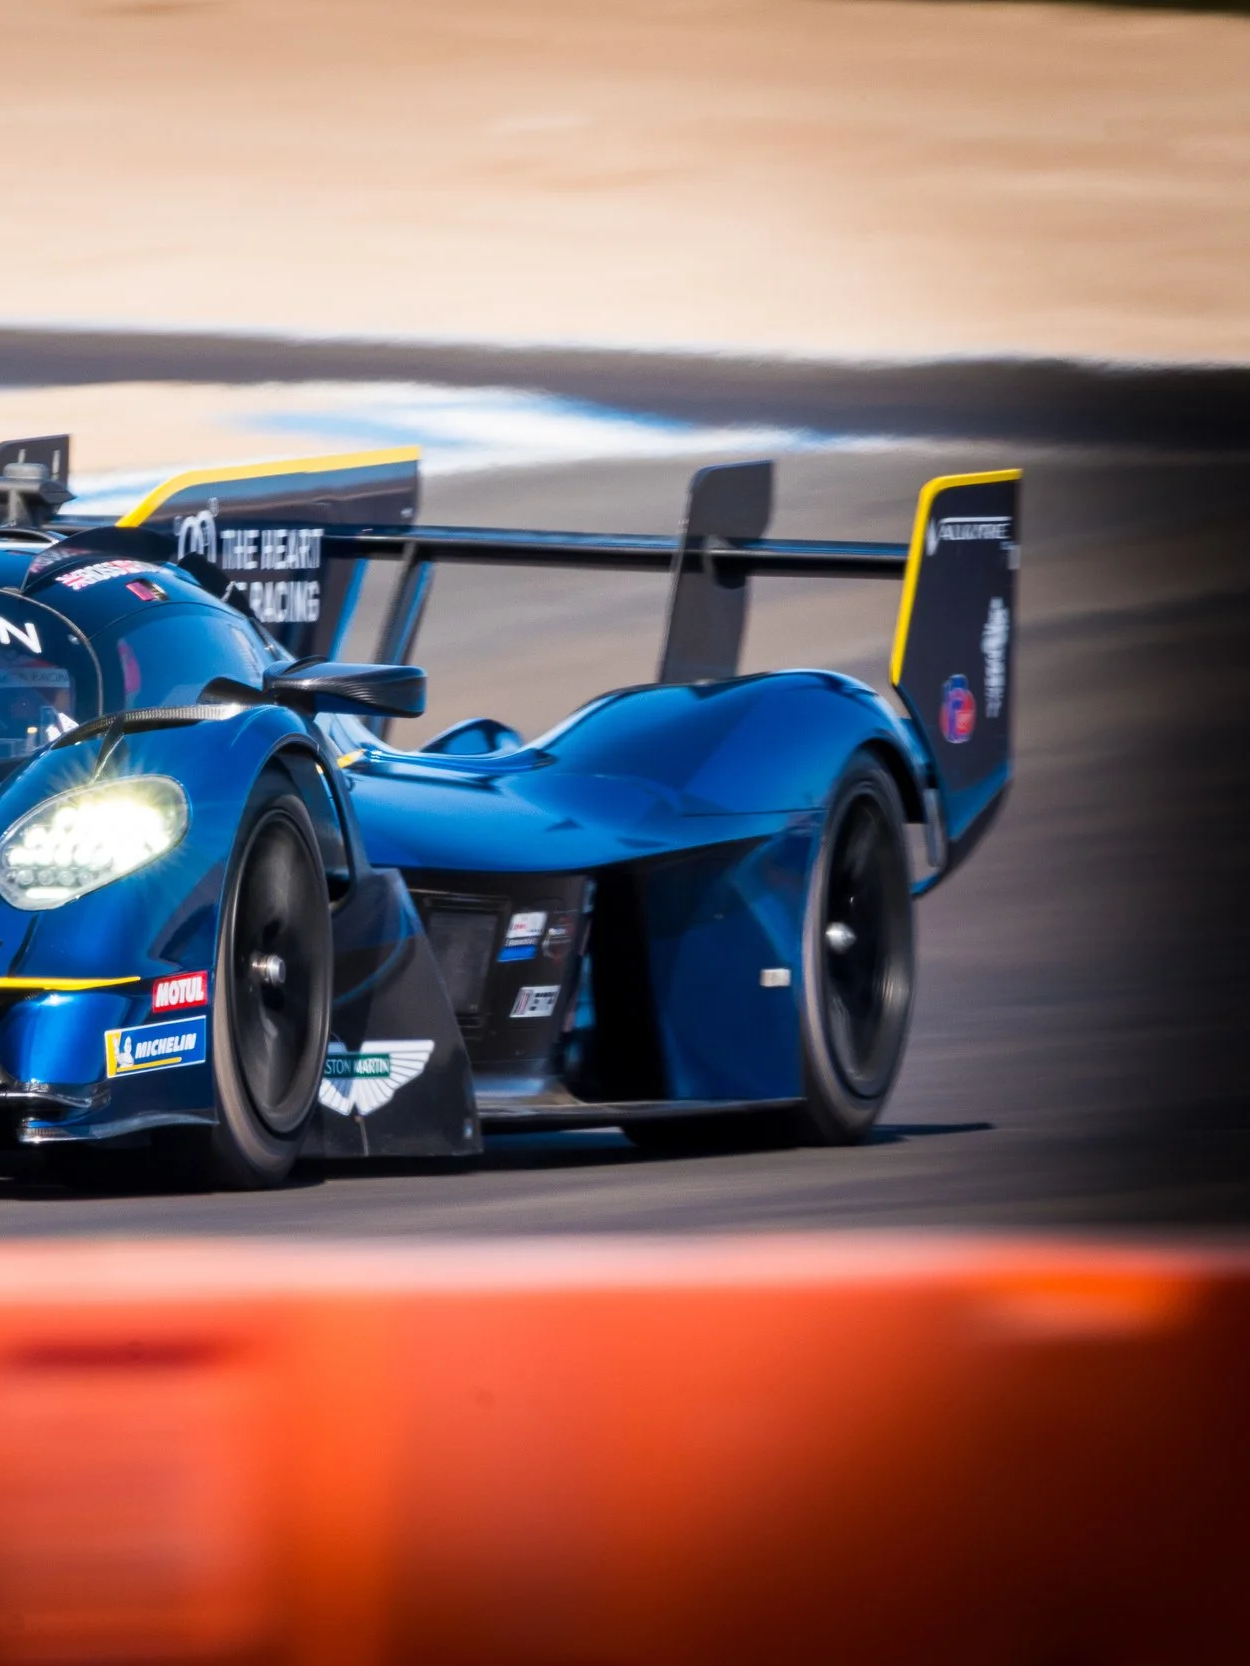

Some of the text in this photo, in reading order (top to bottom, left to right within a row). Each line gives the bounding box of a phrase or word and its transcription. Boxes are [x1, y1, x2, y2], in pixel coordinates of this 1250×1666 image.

[220, 528, 325, 570] THE HEART
[250, 580, 321, 623] RACING
[155, 974, 205, 1008] MOTUL
[134, 1032, 197, 1060] MICHELIN
[324, 1058, 390, 1075] STON MARTIN
